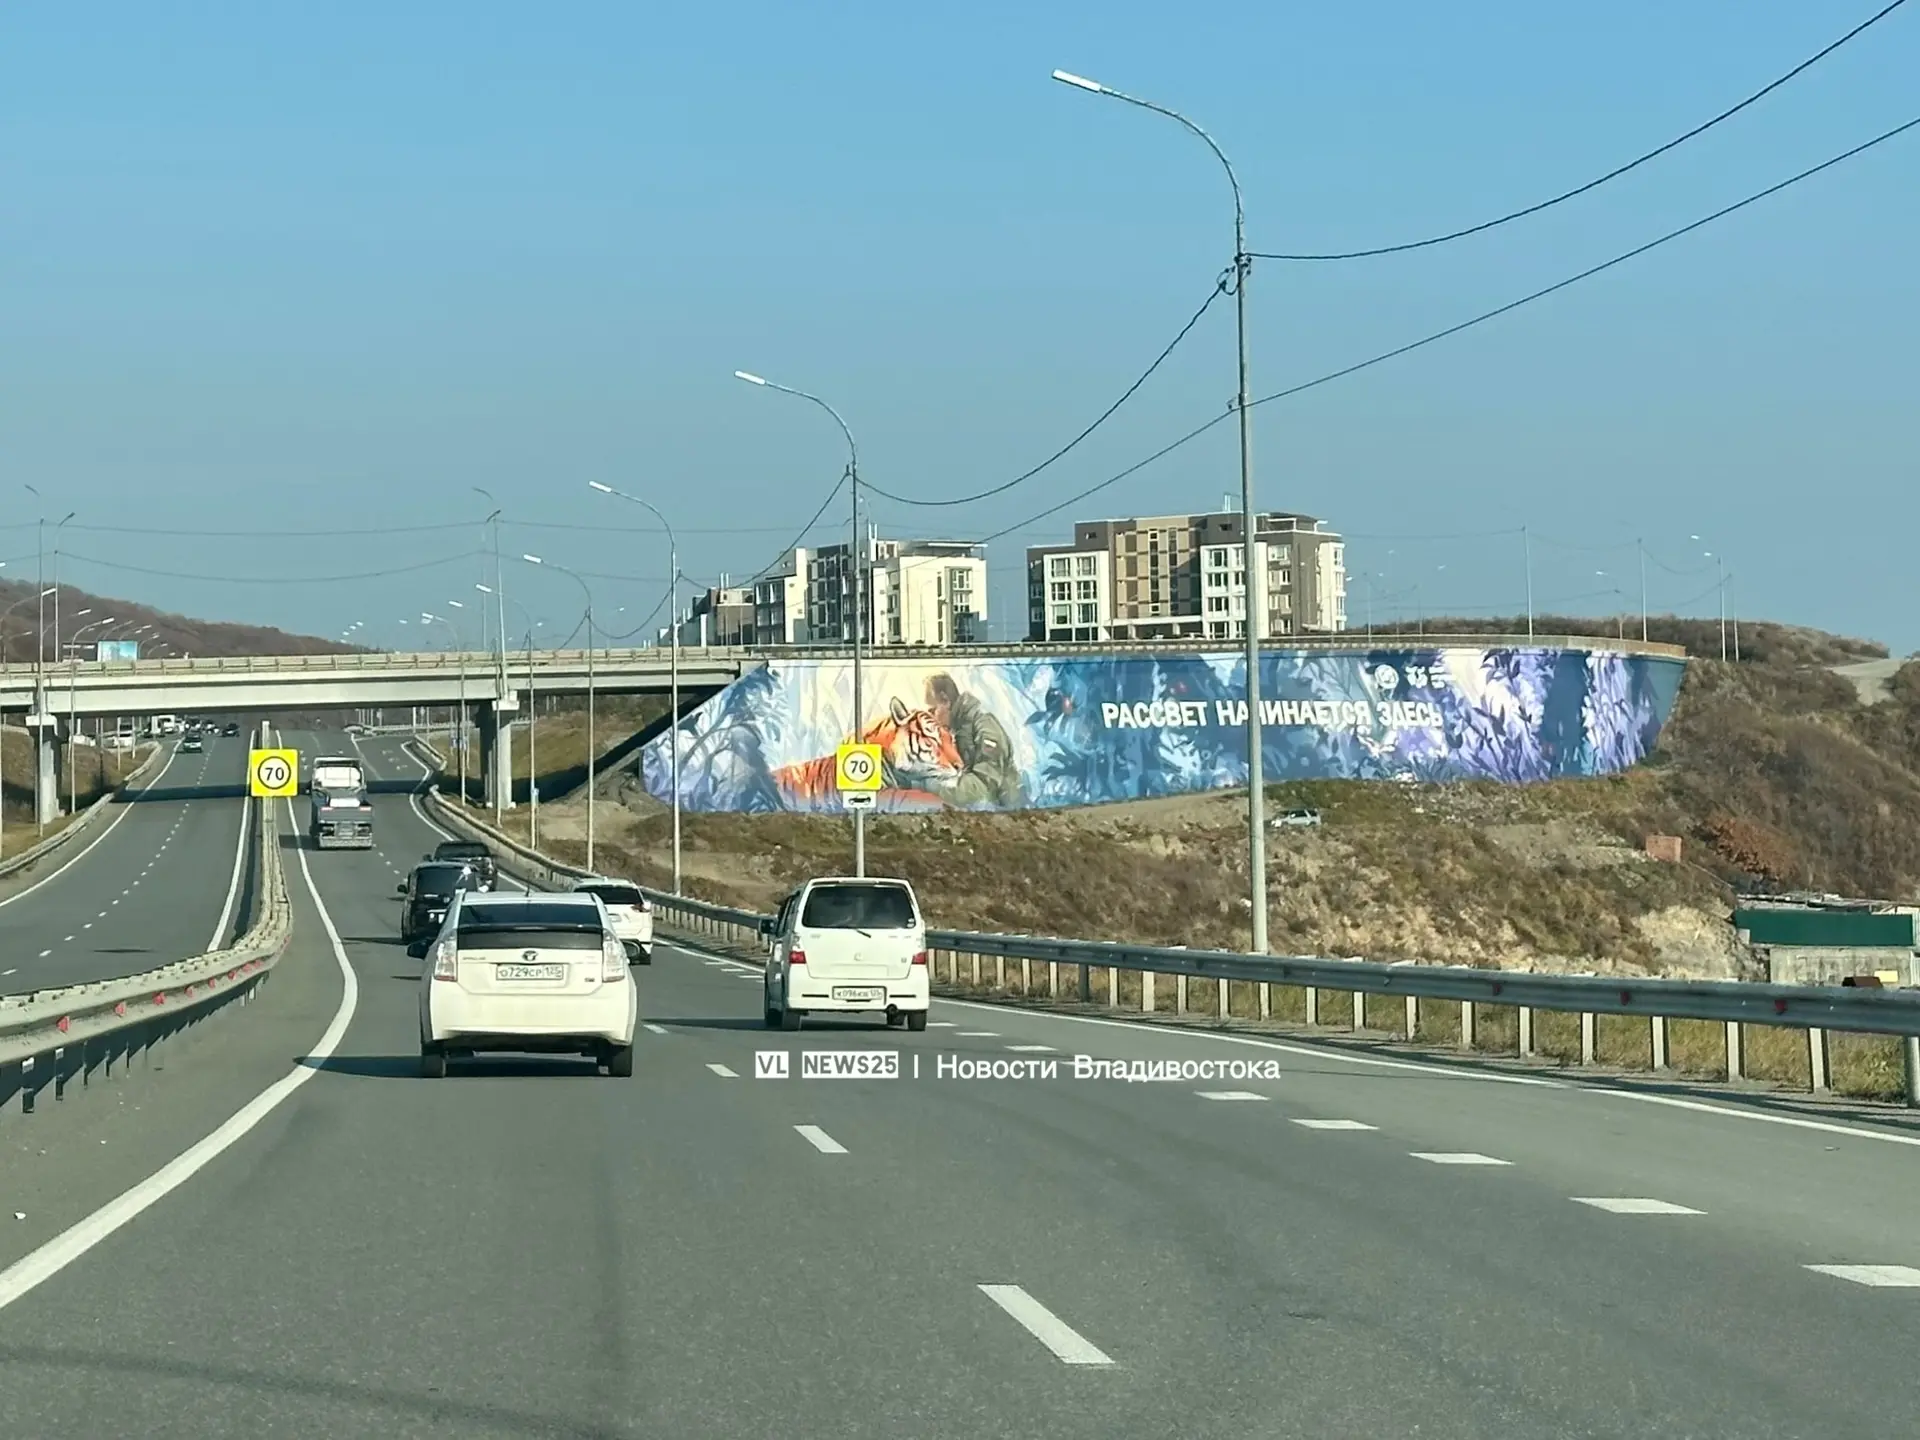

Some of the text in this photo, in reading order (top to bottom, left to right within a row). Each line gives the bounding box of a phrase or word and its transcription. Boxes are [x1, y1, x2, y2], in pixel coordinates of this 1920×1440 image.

[1101, 700, 1208, 728] РАССВЕТ
[1376, 700, 1444, 730] ЗДЕСЬ
[850, 760, 868, 773] 70
[264, 767, 284, 780] 70
